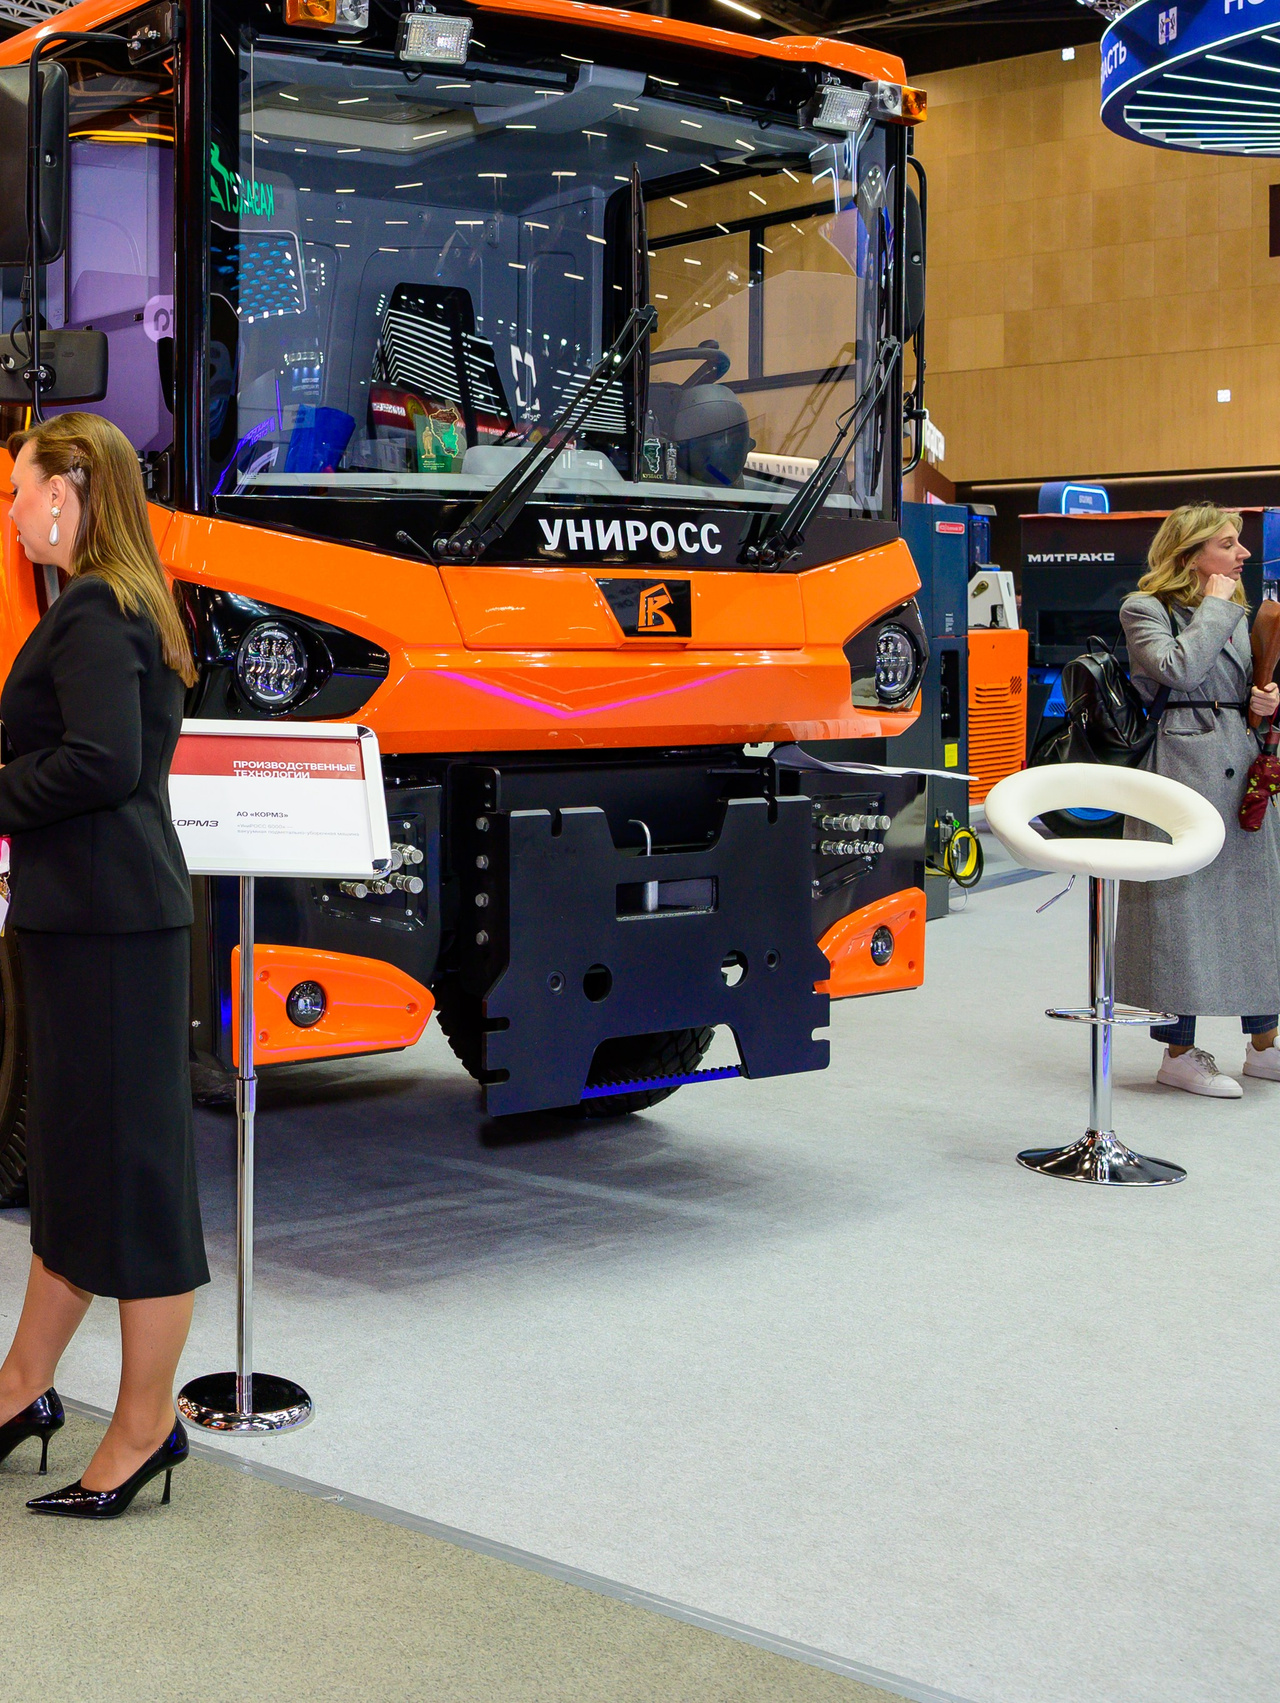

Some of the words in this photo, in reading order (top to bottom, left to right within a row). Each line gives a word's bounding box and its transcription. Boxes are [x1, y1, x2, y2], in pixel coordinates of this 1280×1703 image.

[538, 519, 722, 555] УНИРОСС
[1027, 552, 1115, 563] МИТРАКС
[233, 760, 357, 772] ПРОИЗВОДСТВЕННЫЕ
[234, 769, 311, 779] ТЕХНОЛОГИИ
